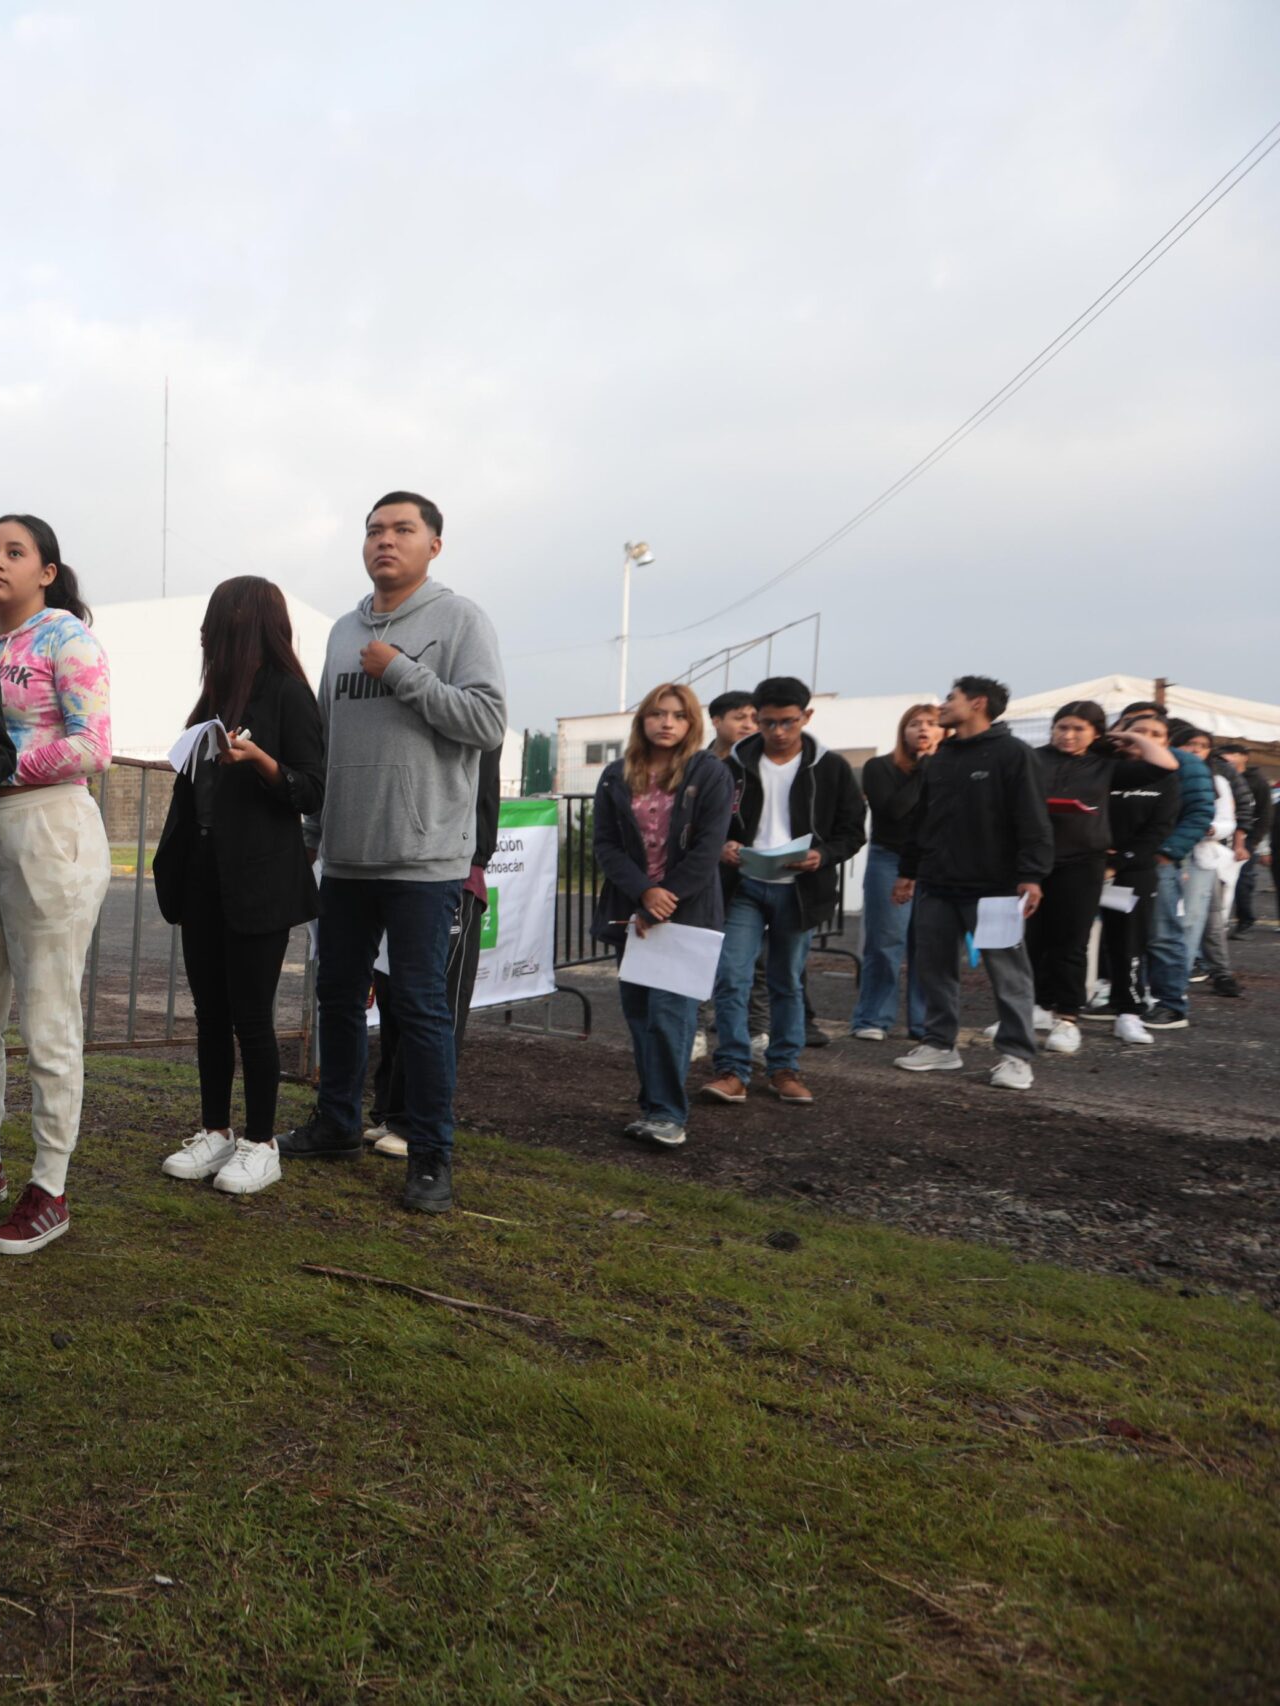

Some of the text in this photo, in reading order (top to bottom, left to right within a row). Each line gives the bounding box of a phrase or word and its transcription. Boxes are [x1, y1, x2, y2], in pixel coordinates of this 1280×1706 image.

[0, 665, 33, 688] ORK
[495, 834, 524, 852] ción
[486, 859, 524, 874] choacán
